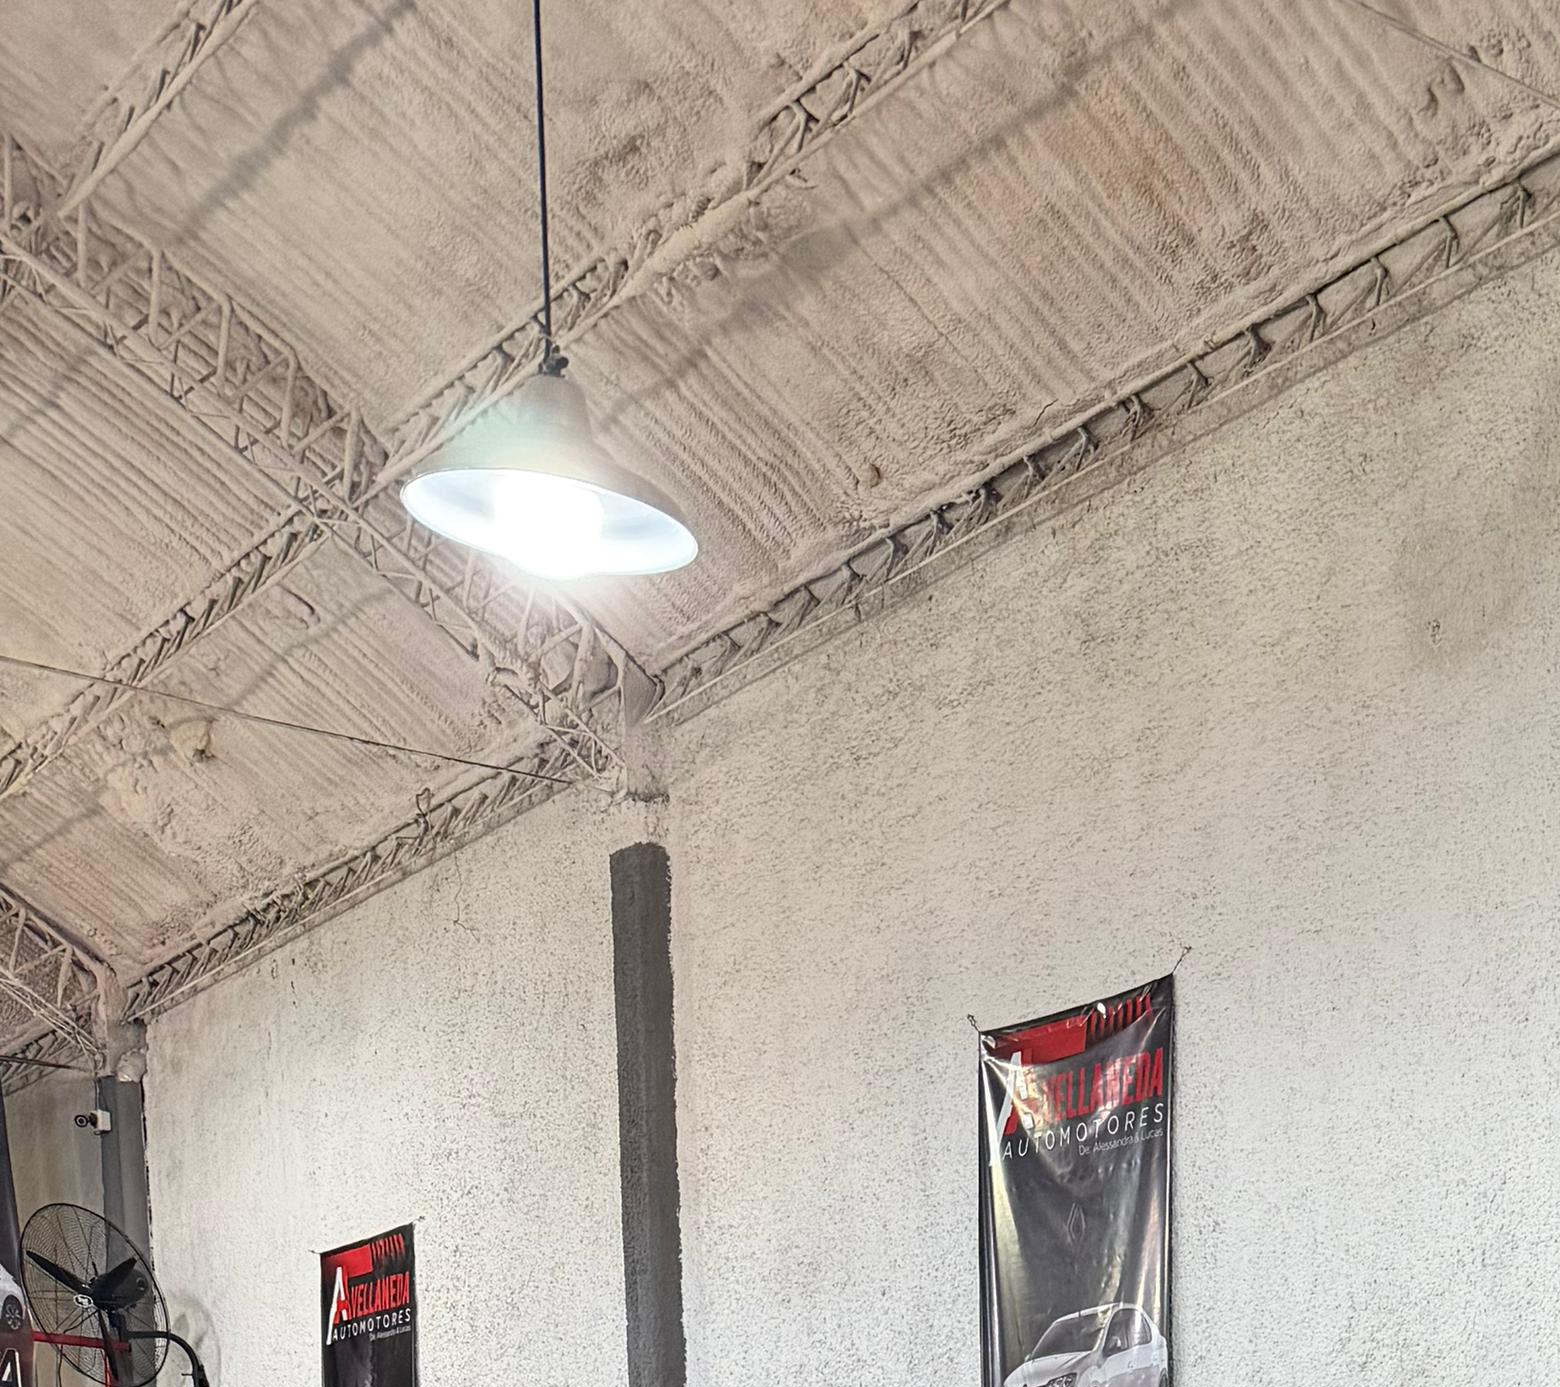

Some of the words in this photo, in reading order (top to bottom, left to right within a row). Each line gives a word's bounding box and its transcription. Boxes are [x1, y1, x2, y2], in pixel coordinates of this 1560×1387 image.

[1003, 1103, 1164, 1160] AUTOMOTORES
[326, 1266, 409, 1345] AVELLANEDA
[333, 1308, 411, 1341] AUTOMOTORES
